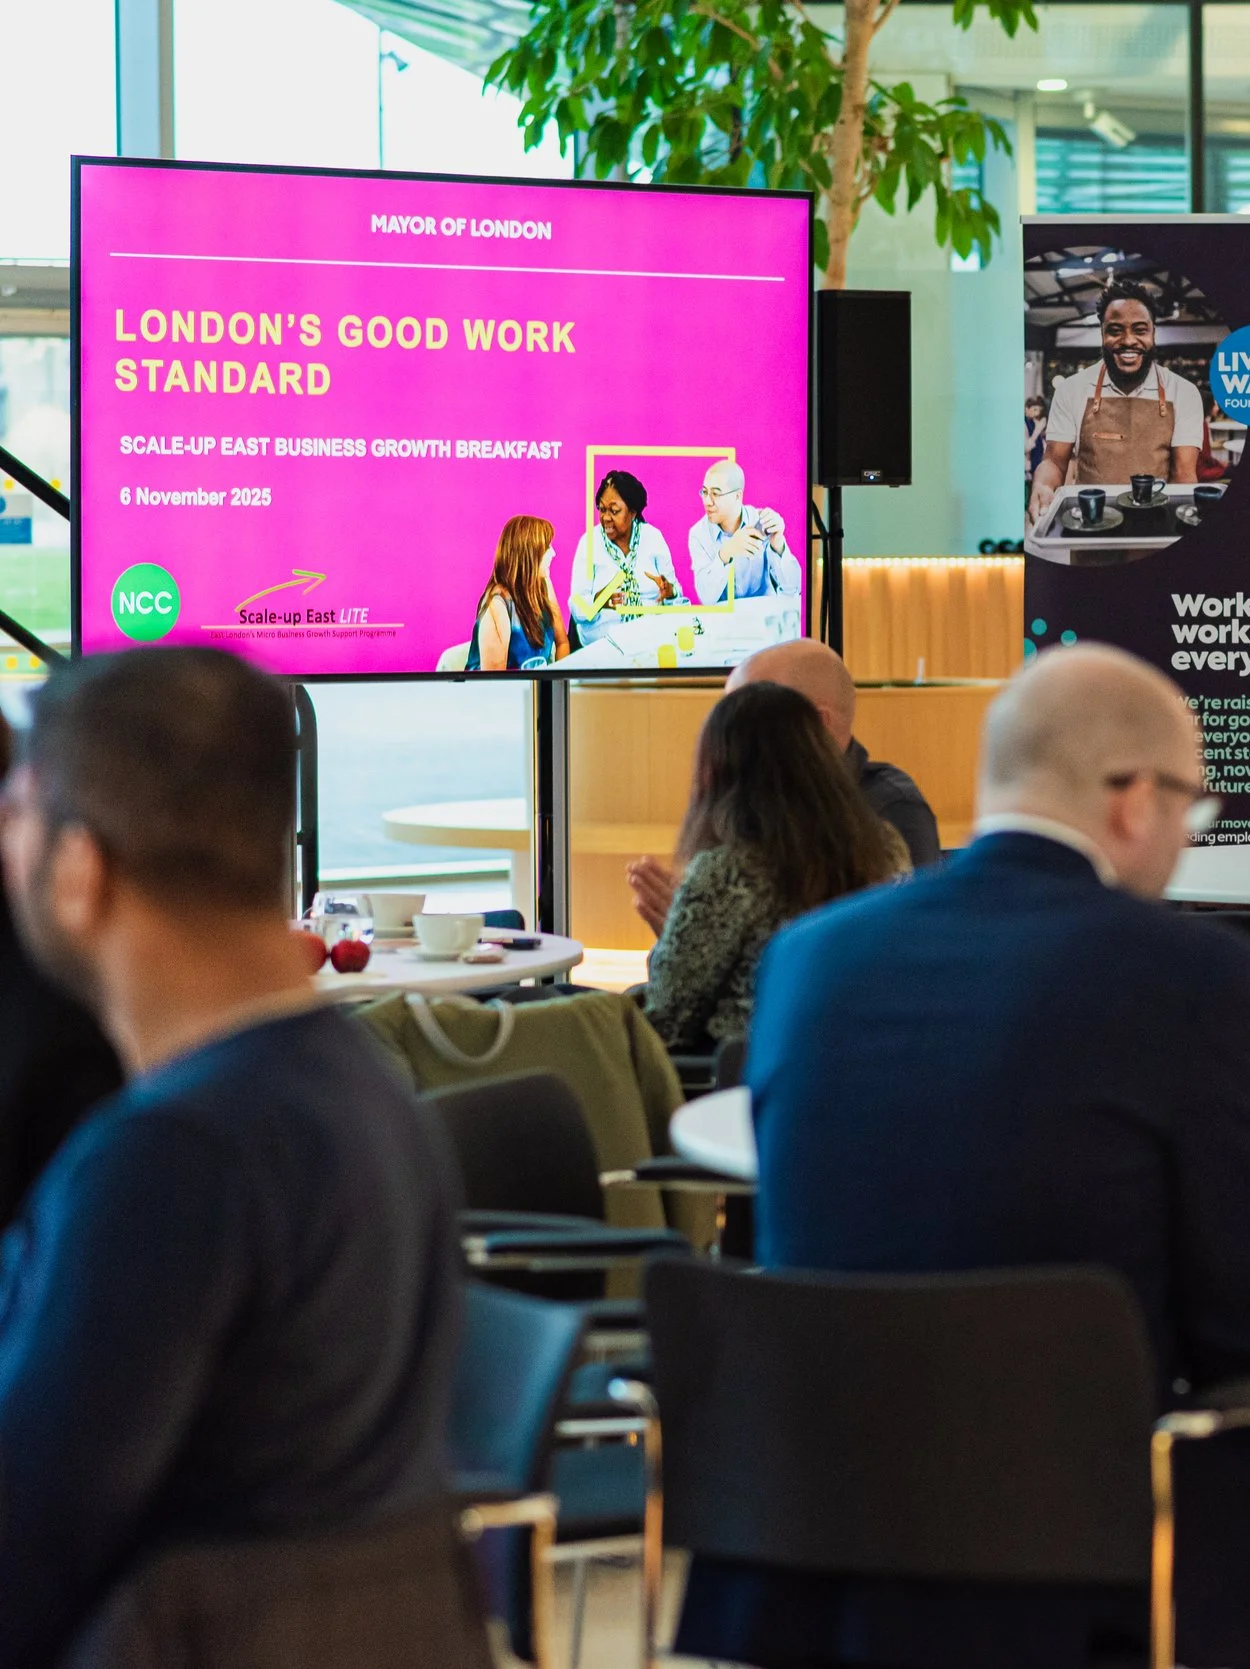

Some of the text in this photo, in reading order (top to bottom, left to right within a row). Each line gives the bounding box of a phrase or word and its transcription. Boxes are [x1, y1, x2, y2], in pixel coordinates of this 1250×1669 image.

[371, 214, 552, 240] MAYOR OF LONDON
[115, 308, 576, 353] LONDON'S GOOD WORK
[115, 358, 331, 396] STANDARD
[120, 435, 563, 460] SCALE-UP EAST BUSINESS GROWTH BREAKFAST
[119, 486, 272, 507] 6 November 2025
[118, 591, 173, 615] NCC
[239, 607, 370, 626] Scale-up East LITE
[256, 630, 276, 639] Micro
[277, 630, 305, 639] Business
[306, 629, 331, 638] Growth
[332, 629, 358, 640] Support
[359, 629, 397, 640] Programme
[1202, 711, 1227, 727] for
